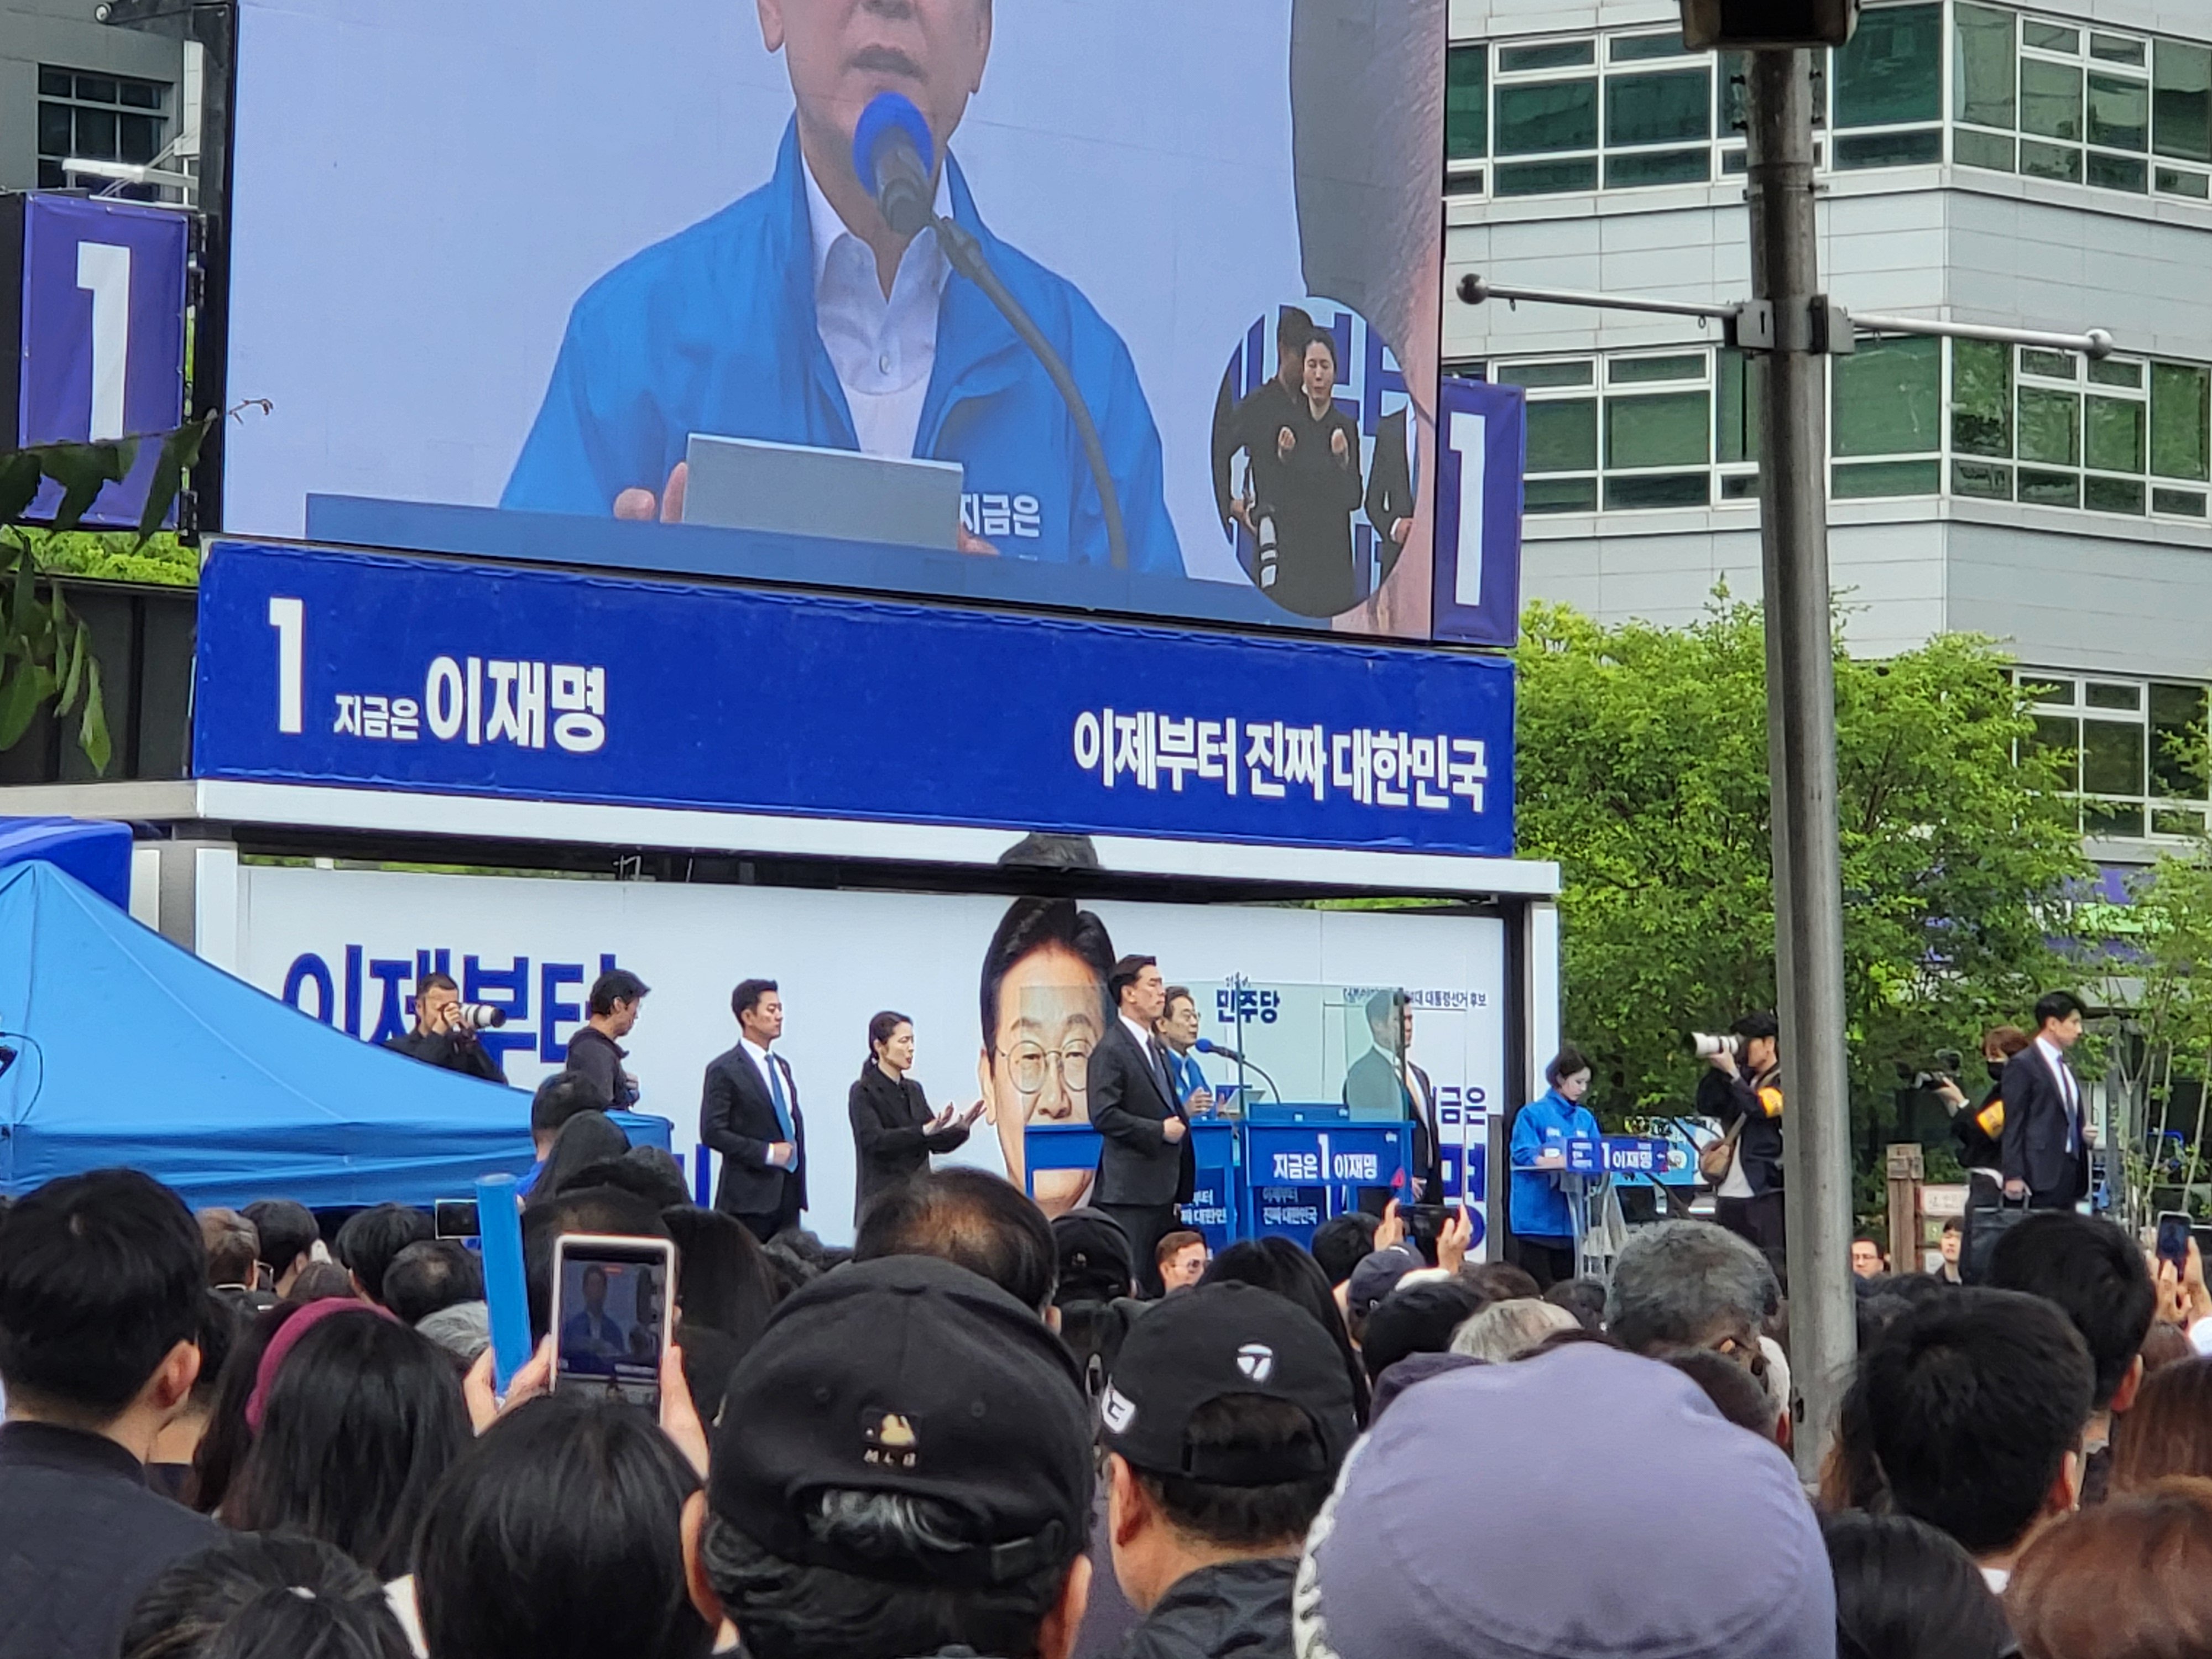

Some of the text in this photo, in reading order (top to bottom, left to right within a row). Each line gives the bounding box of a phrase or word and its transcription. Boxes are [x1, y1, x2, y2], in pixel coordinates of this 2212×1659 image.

[77, 241, 131, 442] 1
[1449, 411, 1486, 606] 1
[269, 597, 606, 753] 1 지금은 이재명
[1073, 708, 1488, 813] 이제부터 진짜 대한민국
[1216, 989, 1280, 1024] 민주당
[1432, 1086, 1486, 1125] 금은
[1274, 1133, 1378, 1180] 지금은 1 이재명
[1613, 1151, 1652, 1169] 이재명
